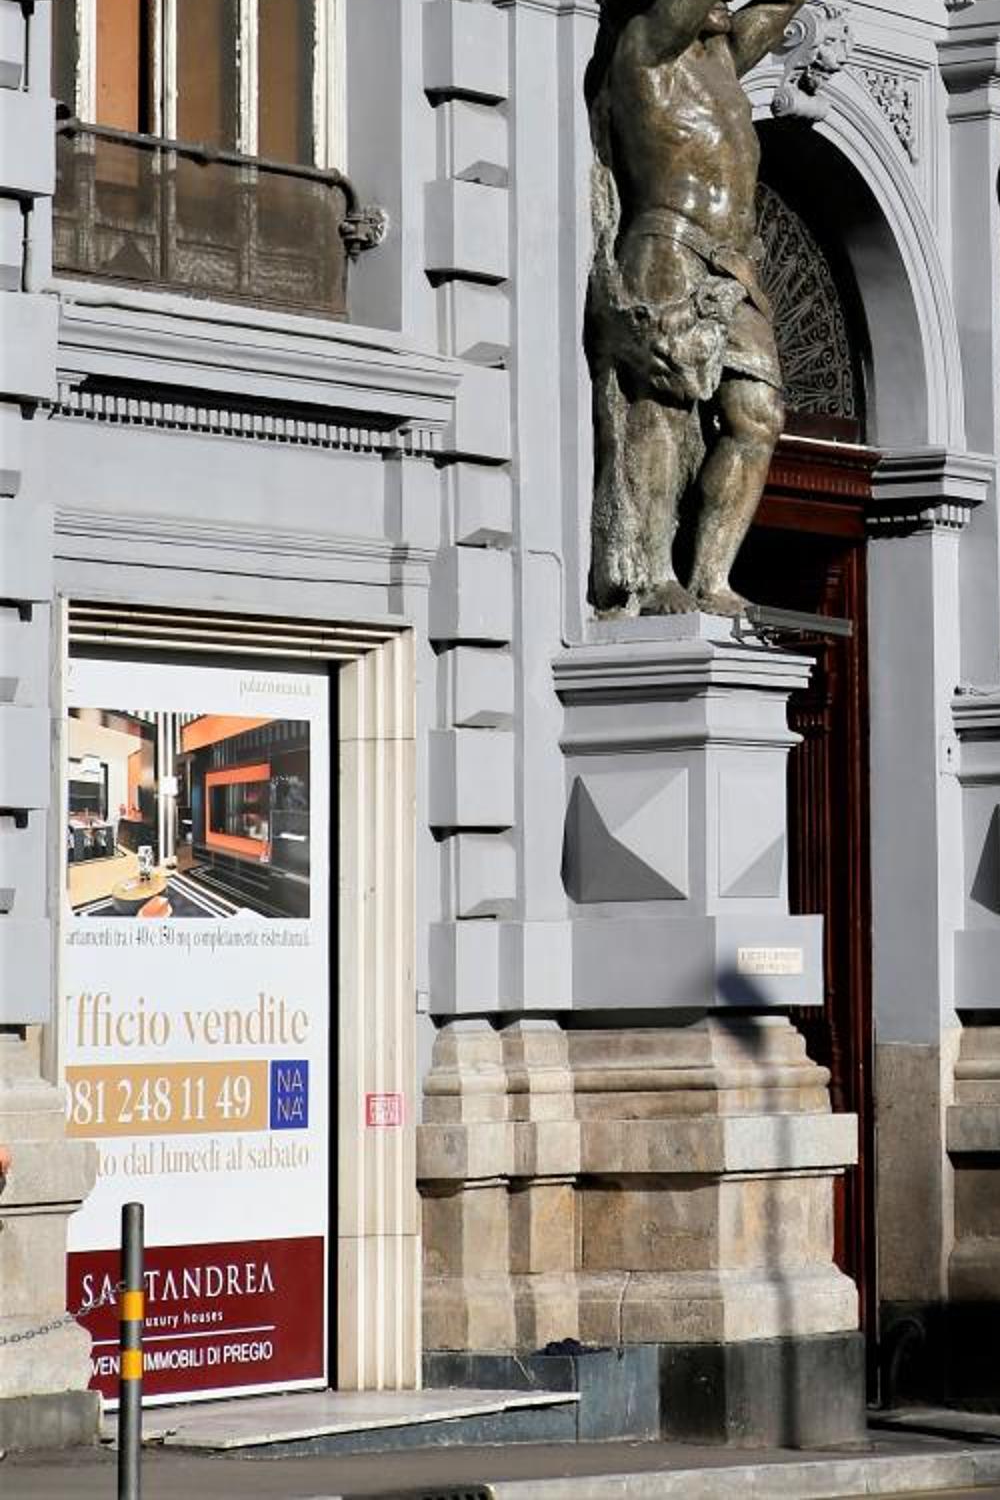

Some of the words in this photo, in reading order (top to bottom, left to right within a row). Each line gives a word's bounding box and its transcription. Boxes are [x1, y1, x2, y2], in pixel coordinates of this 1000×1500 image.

[182, 992, 310, 1046] vendite
[117, 1076, 172, 1123] 248
[181, 1076, 207, 1122] 11
[215, 1074, 252, 1122] 49
[276, 1067, 304, 1093] NA
[123, 1139, 155, 1177] dal
[225, 1136, 243, 1172] al
[248, 1135, 310, 1171] sabato
[81, 1261, 275, 1308] SATANDREA
[144, 1313, 179, 1329] uxury
[183, 1310, 223, 1325] houses
[91, 1355, 120, 1376] VEN
[143, 1348, 204, 1372] IMMOBILI
[207, 1347, 220, 1365] DI
[223, 1341, 273, 1364] PREGIO
